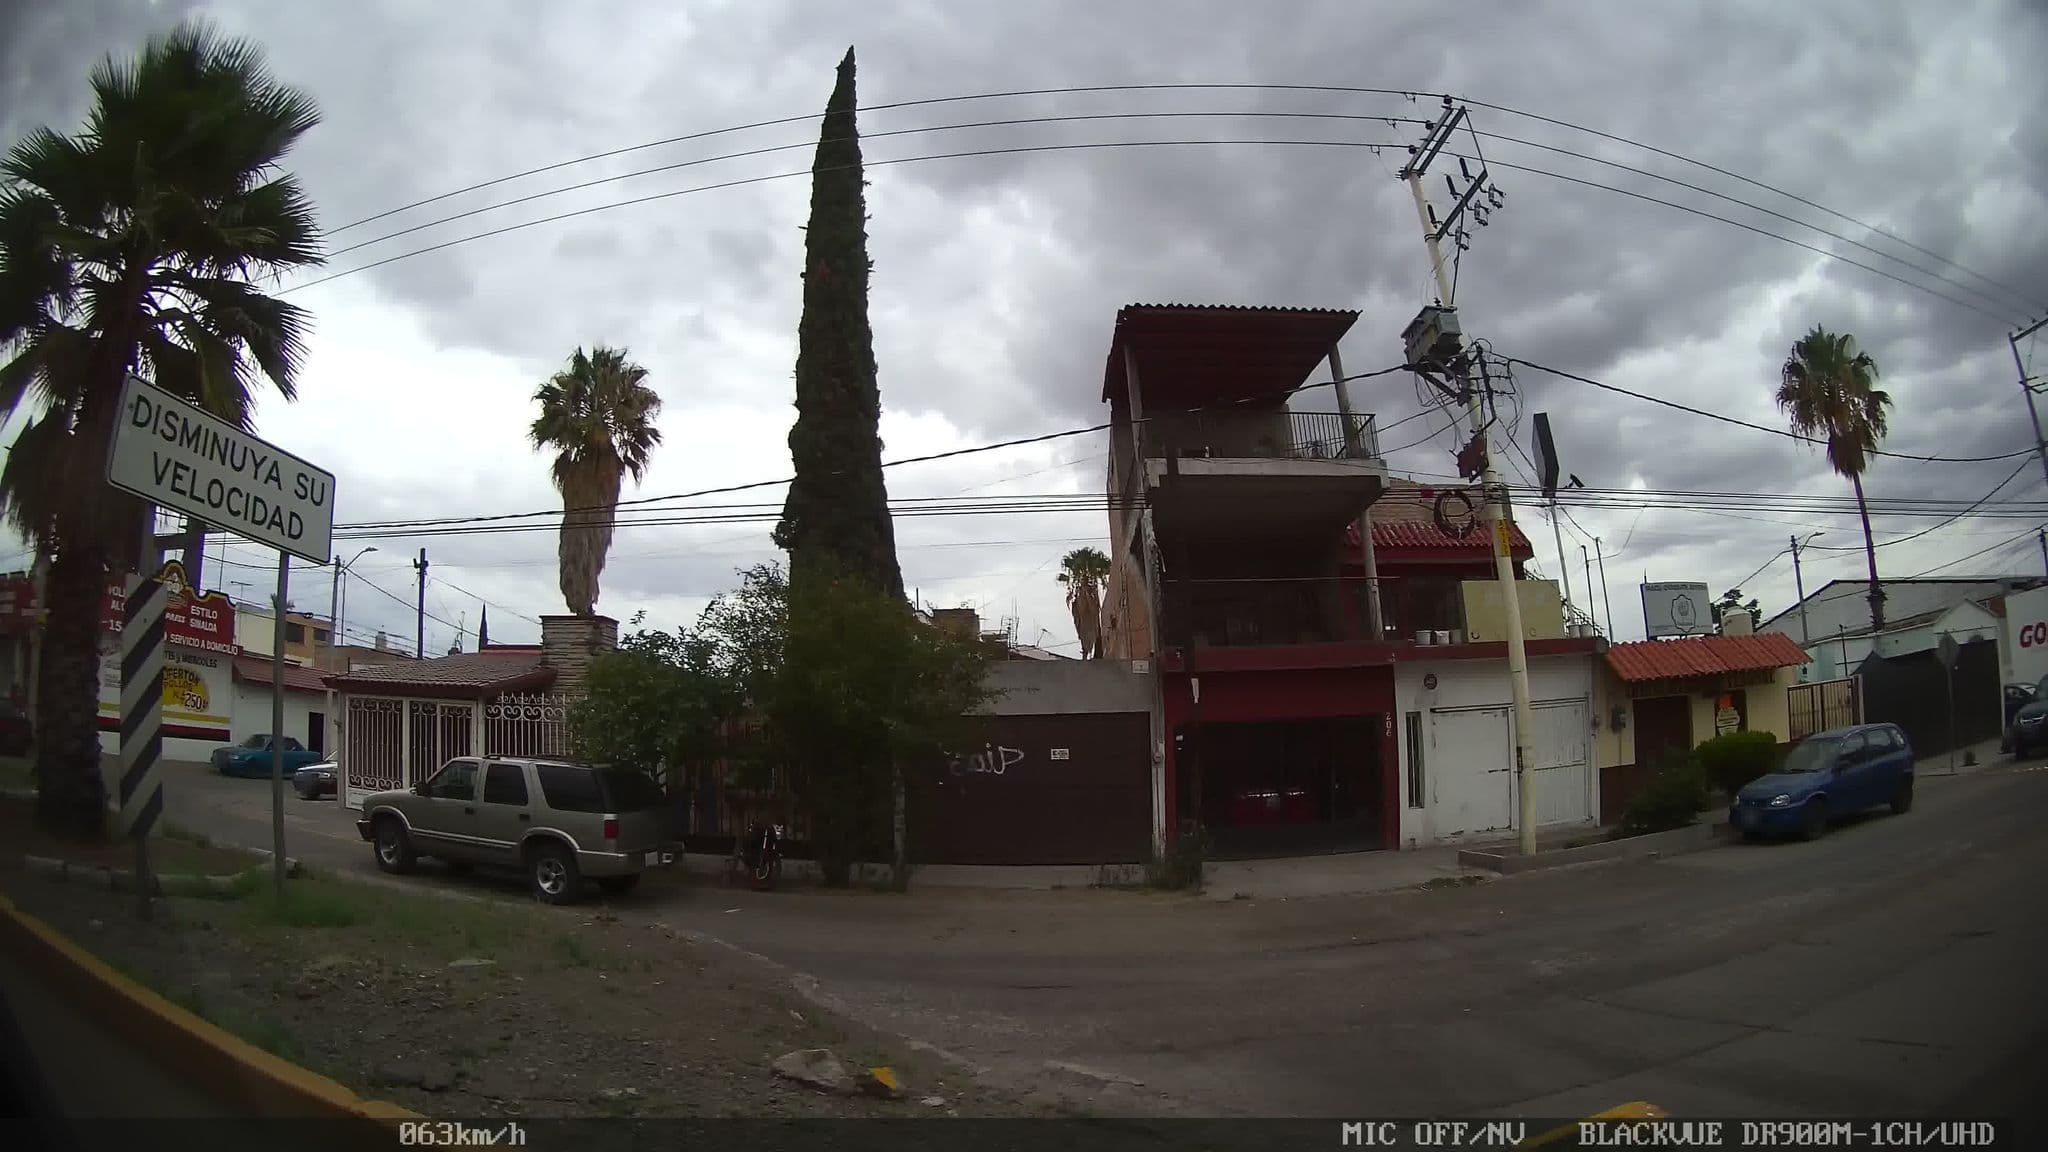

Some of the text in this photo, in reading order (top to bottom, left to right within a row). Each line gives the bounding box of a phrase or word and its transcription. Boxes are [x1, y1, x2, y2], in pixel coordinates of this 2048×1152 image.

[132, 394, 325, 507] DISMINUYA SU
[153, 451, 304, 541] VELOCIDAD
[190, 605, 218, 620] ESTILO
[169, 632, 238, 656] SERVICIO A DOMICILIO
